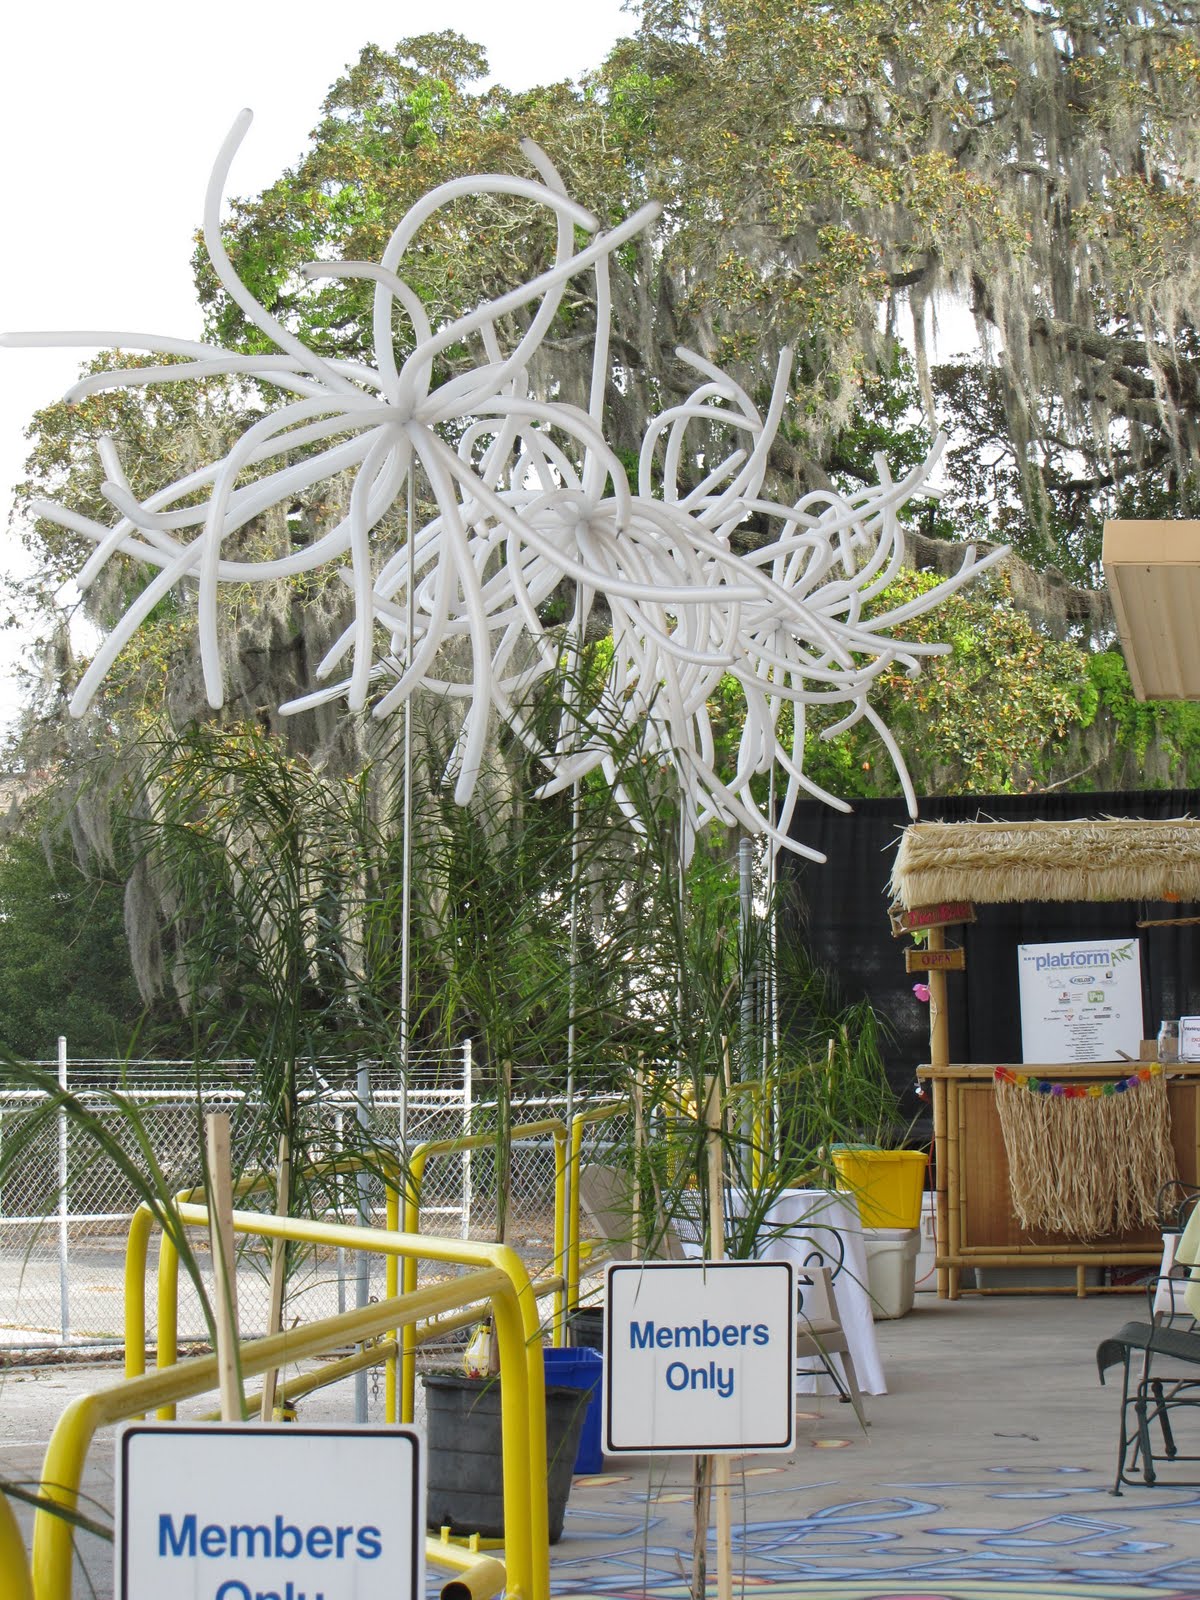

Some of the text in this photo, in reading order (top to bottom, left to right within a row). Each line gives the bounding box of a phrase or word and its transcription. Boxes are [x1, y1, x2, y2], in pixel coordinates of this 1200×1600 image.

[921, 953, 952, 966] OPEN
[630, 1320, 769, 1351] Members
[666, 1361, 735, 1399] Only
[159, 1514, 383, 1560] Members
[215, 1580, 324, 1600] Ol
